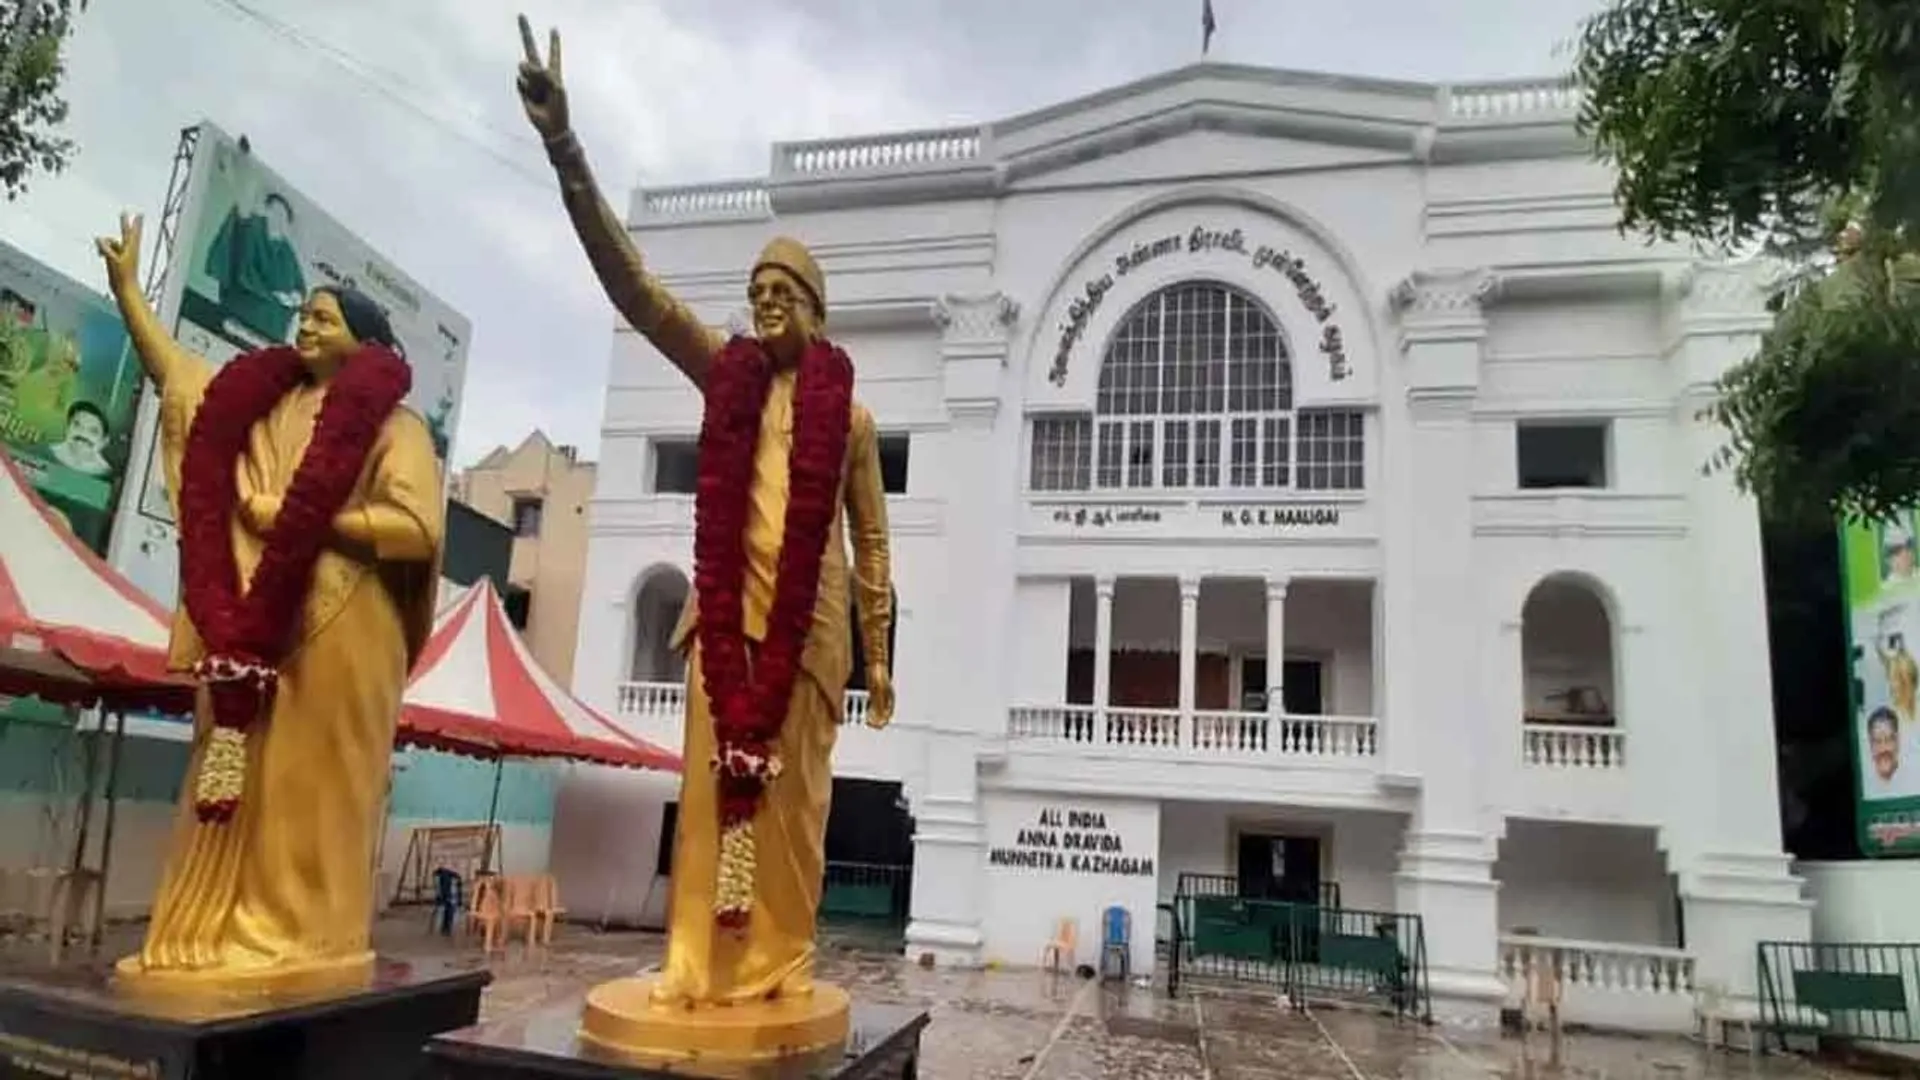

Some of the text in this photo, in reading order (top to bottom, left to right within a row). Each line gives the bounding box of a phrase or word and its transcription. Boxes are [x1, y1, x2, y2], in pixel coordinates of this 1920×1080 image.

[1115, 234, 1181, 276] அண்ணா
[1320, 324, 1353, 381] கழகம்
[1274, 509, 1339, 525] MAALIGAI
[1039, 807, 1107, 829] ALL INDIA
[1016, 829, 1123, 852] ANNA DRAVIDA
[989, 848, 1155, 877] MUNNETRA KAZHAGAM
